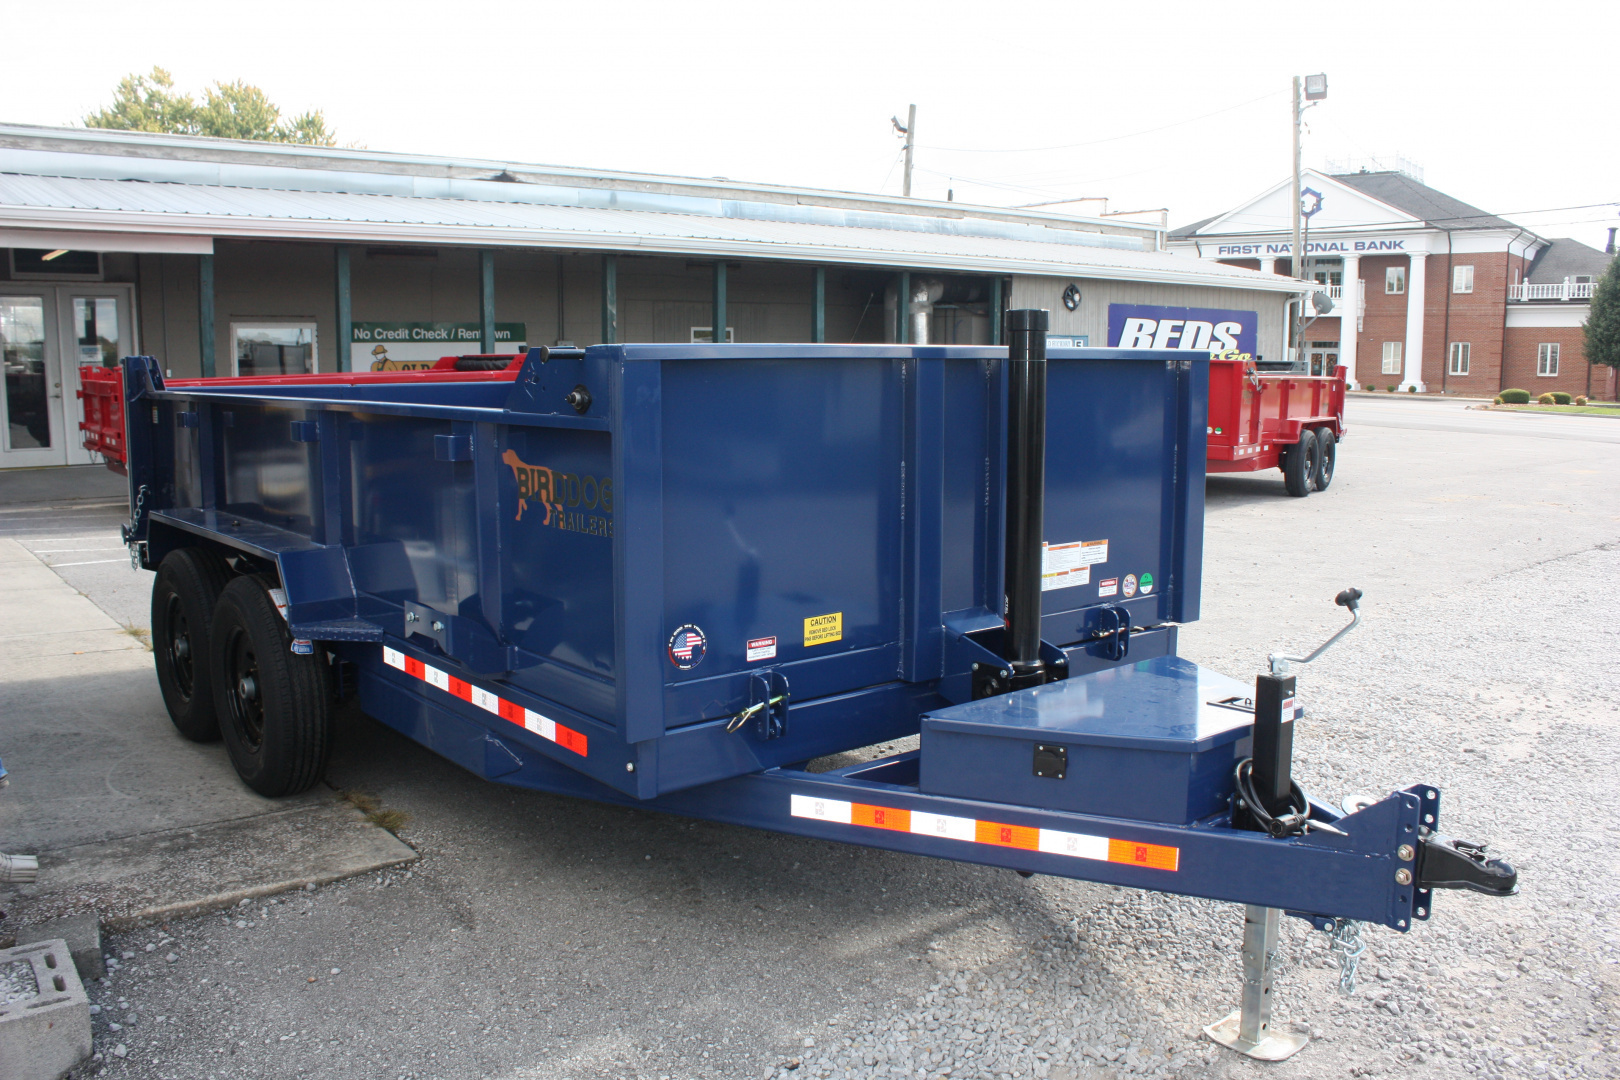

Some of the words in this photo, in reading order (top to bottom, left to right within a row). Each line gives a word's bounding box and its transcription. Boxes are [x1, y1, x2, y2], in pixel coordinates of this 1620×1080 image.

[1218, 244, 1262, 255] FIRST
[1266, 242, 1349, 254] NAONAL
[1354, 240, 1405, 251] BANK
[354, 328, 370, 340] No
[374, 328, 409, 340] Credit
[412, 328, 449, 340] Check
[450, 328, 455, 340] /
[494, 330, 510, 339] wn
[1118, 317, 1242, 356] REDS
[1219, 348, 1253, 361] Go
[516, 466, 613, 513] BIRDDOG
[549, 509, 614, 537] TRAILERS
[810, 615, 837, 627] CAUTION
[750, 639, 773, 648] WARNING
